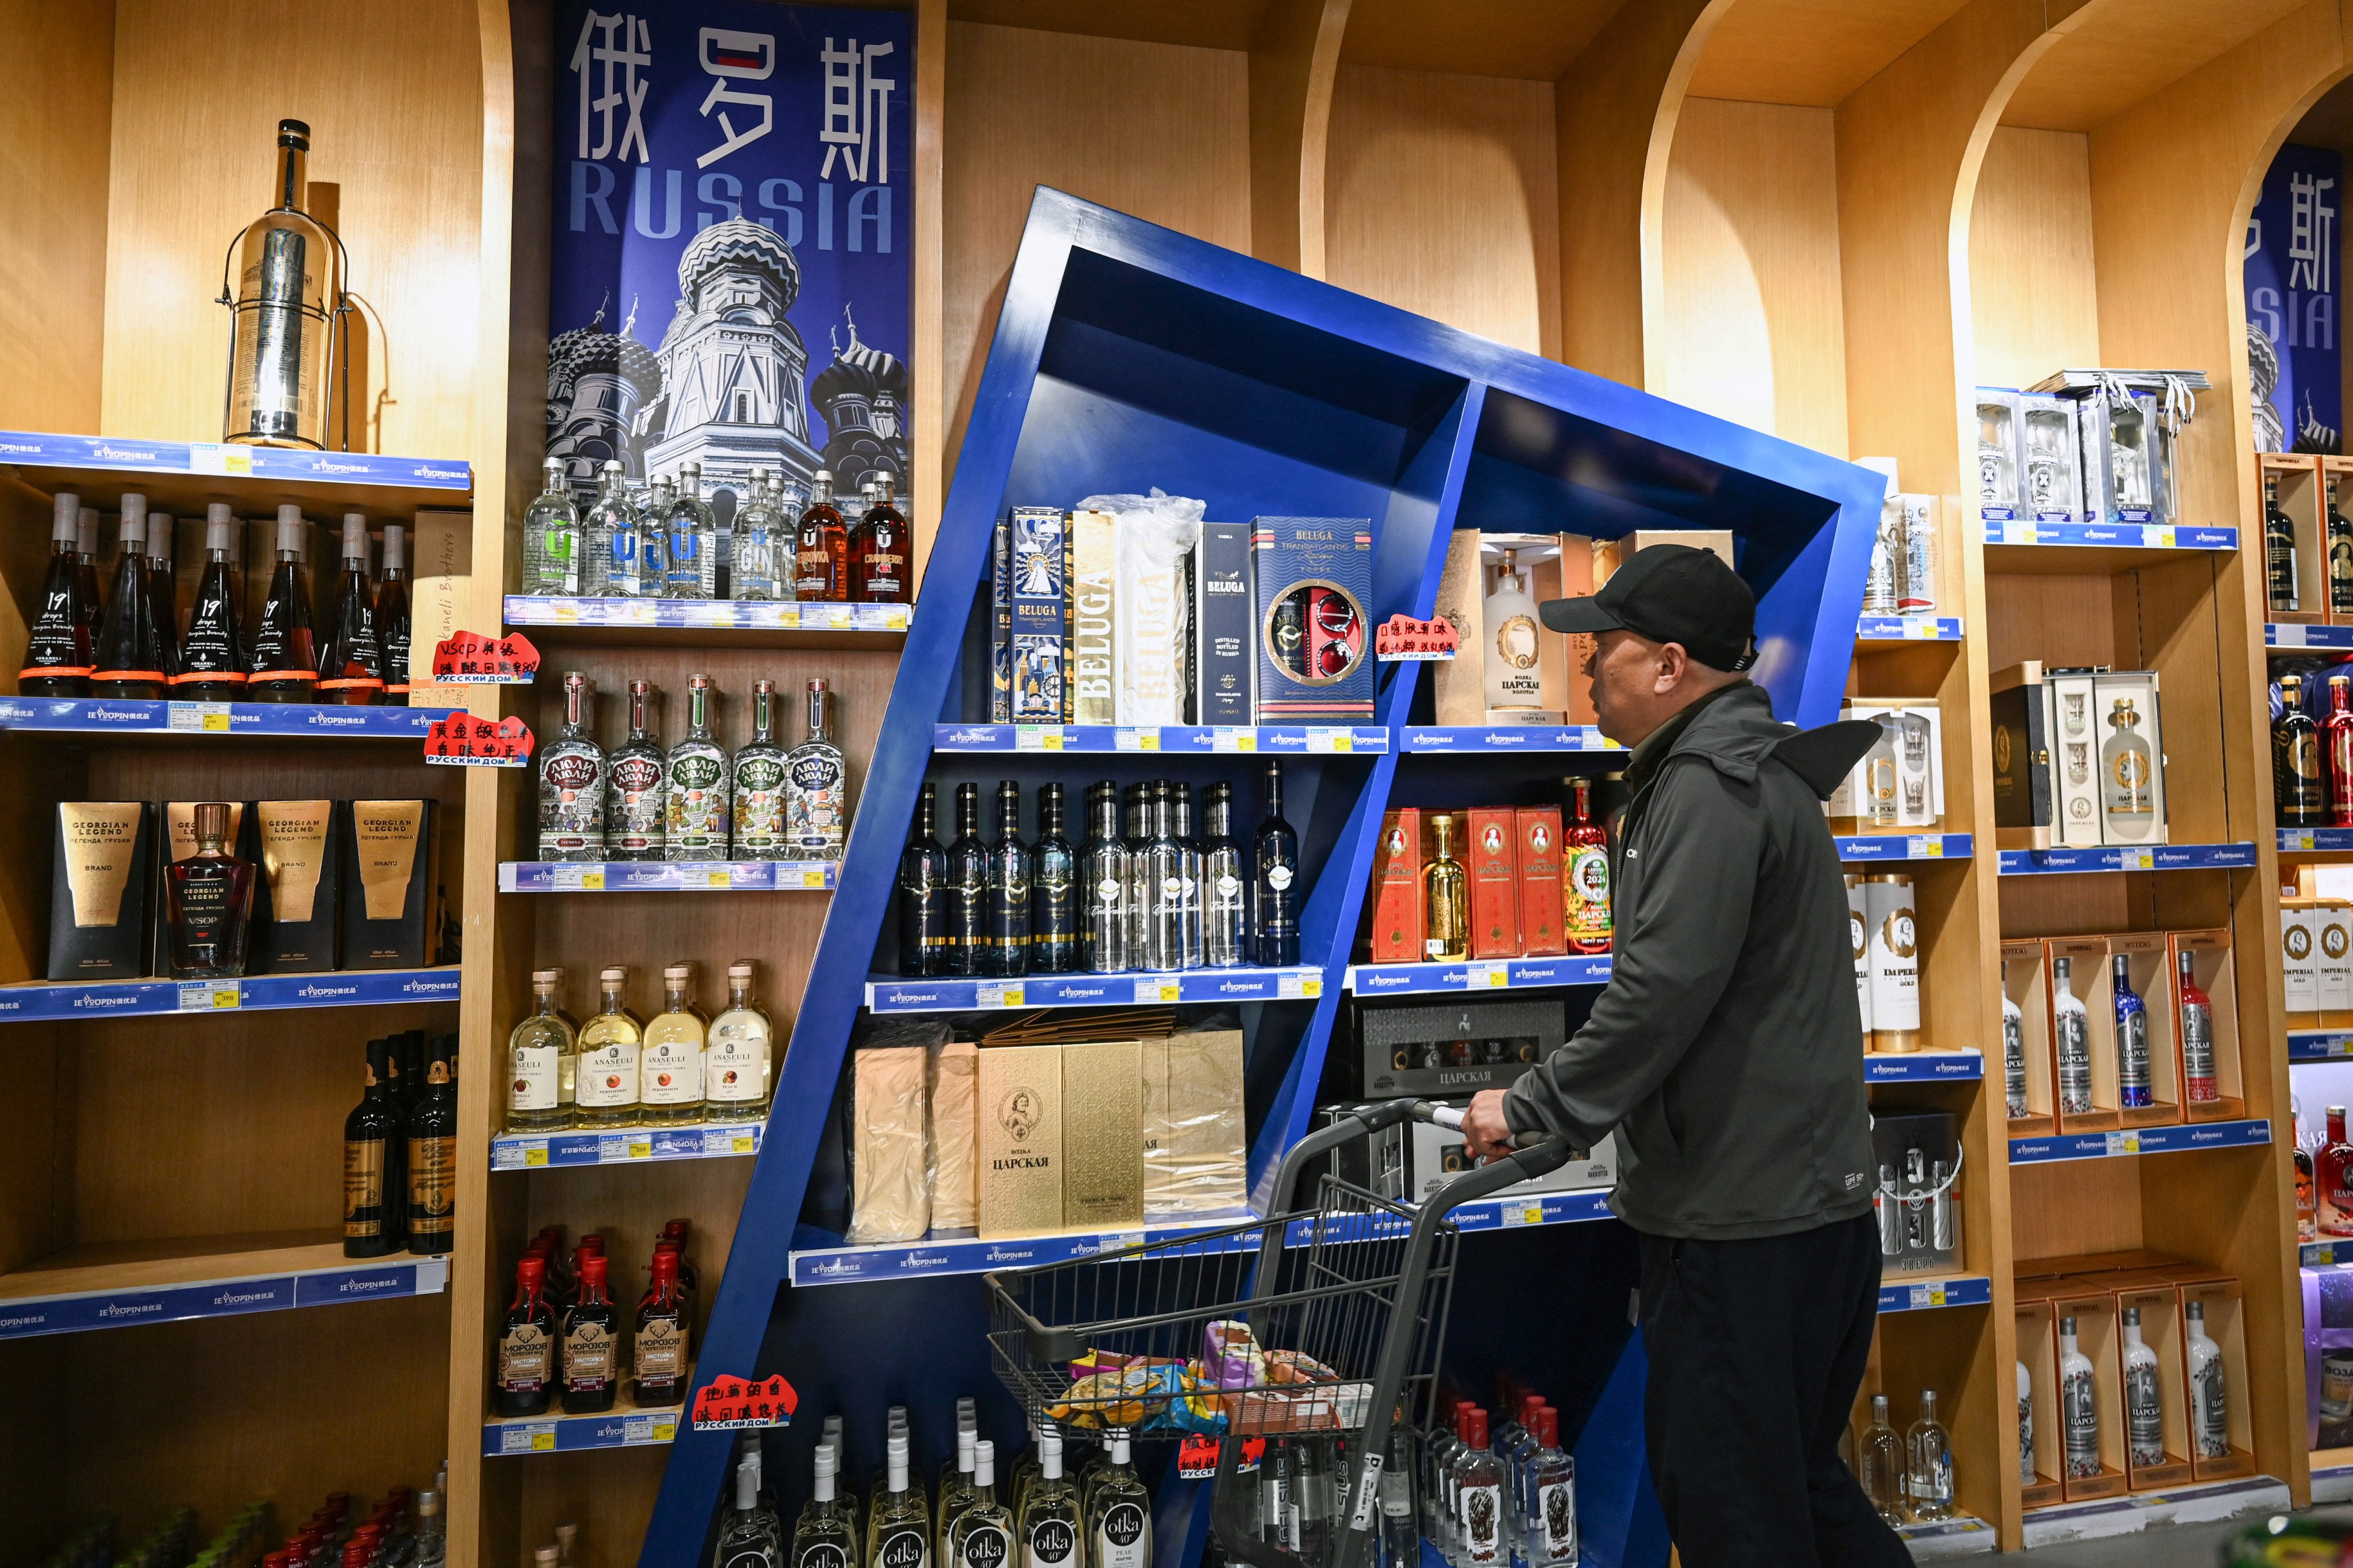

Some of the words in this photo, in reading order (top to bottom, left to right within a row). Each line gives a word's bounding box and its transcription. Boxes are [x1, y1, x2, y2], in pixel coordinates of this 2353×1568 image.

[571, 9, 895, 183] 俄罗斯
[569, 160, 892, 253] RUSSIA
[1296, 530, 1333, 541] BELUGA
[741, 546, 774, 571] GIN
[864, 554, 903, 565] CRANBERRY
[1208, 581, 1245, 593] BELUGA
[48, 591, 67, 611] 19
[202, 599, 221, 618] 19
[264, 600, 279, 618] 19
[1018, 605, 1057, 615] BELUGA
[42, 612, 63, 622] drops
[363, 607, 372, 626] 19
[197, 619, 217, 628] drops
[1078, 569, 1111, 699] BELUGA
[1138, 573, 1169, 700] BELUGA
[441, 643, 477, 659] VSOP
[1501, 681, 1539, 690] ЦАРСКАЯ
[428, 756, 480, 764] РУССКИЙ
[551, 759, 594, 773] ЛЮЛИ
[615, 762, 657, 776] ЛЮЛИ
[677, 759, 718, 774] ЛЮЛИ
[741, 762, 780, 776] ЛЮЛИ
[796, 761, 835, 776] ЛЮЛИ
[554, 770, 591, 782] ЛЮЛИ
[618, 775, 653, 785] ЛЮЛИ
[679, 769, 714, 781] ЛЮЛИ
[744, 772, 777, 784] ЛЮЛИ
[798, 772, 831, 783] ЛЮЛИ
[1262, 854, 1296, 870] BELUGA
[1586, 875, 1605, 884] 2024
[188, 916, 217, 924] VSOP
[594, 1057, 633, 1065] ANASEULI
[2059, 1055, 2089, 1064] ЦАРСКАЯ
[1440, 1071, 1491, 1084] ЦАРСКАЯ
[993, 1156, 1049, 1170] ЦАРСКАЯ
[1844, 1178, 1855, 1187] UPF
[1901, 1257, 1935, 1272] ЗВЕРЬ
[505, 1342, 547, 1351] МОРОЗОВ
[568, 1342, 610, 1350] МОРОЗОВ
[639, 1338, 680, 1347] МОРОЗОВ
[511, 1357, 541, 1365] НАСТОЙКА
